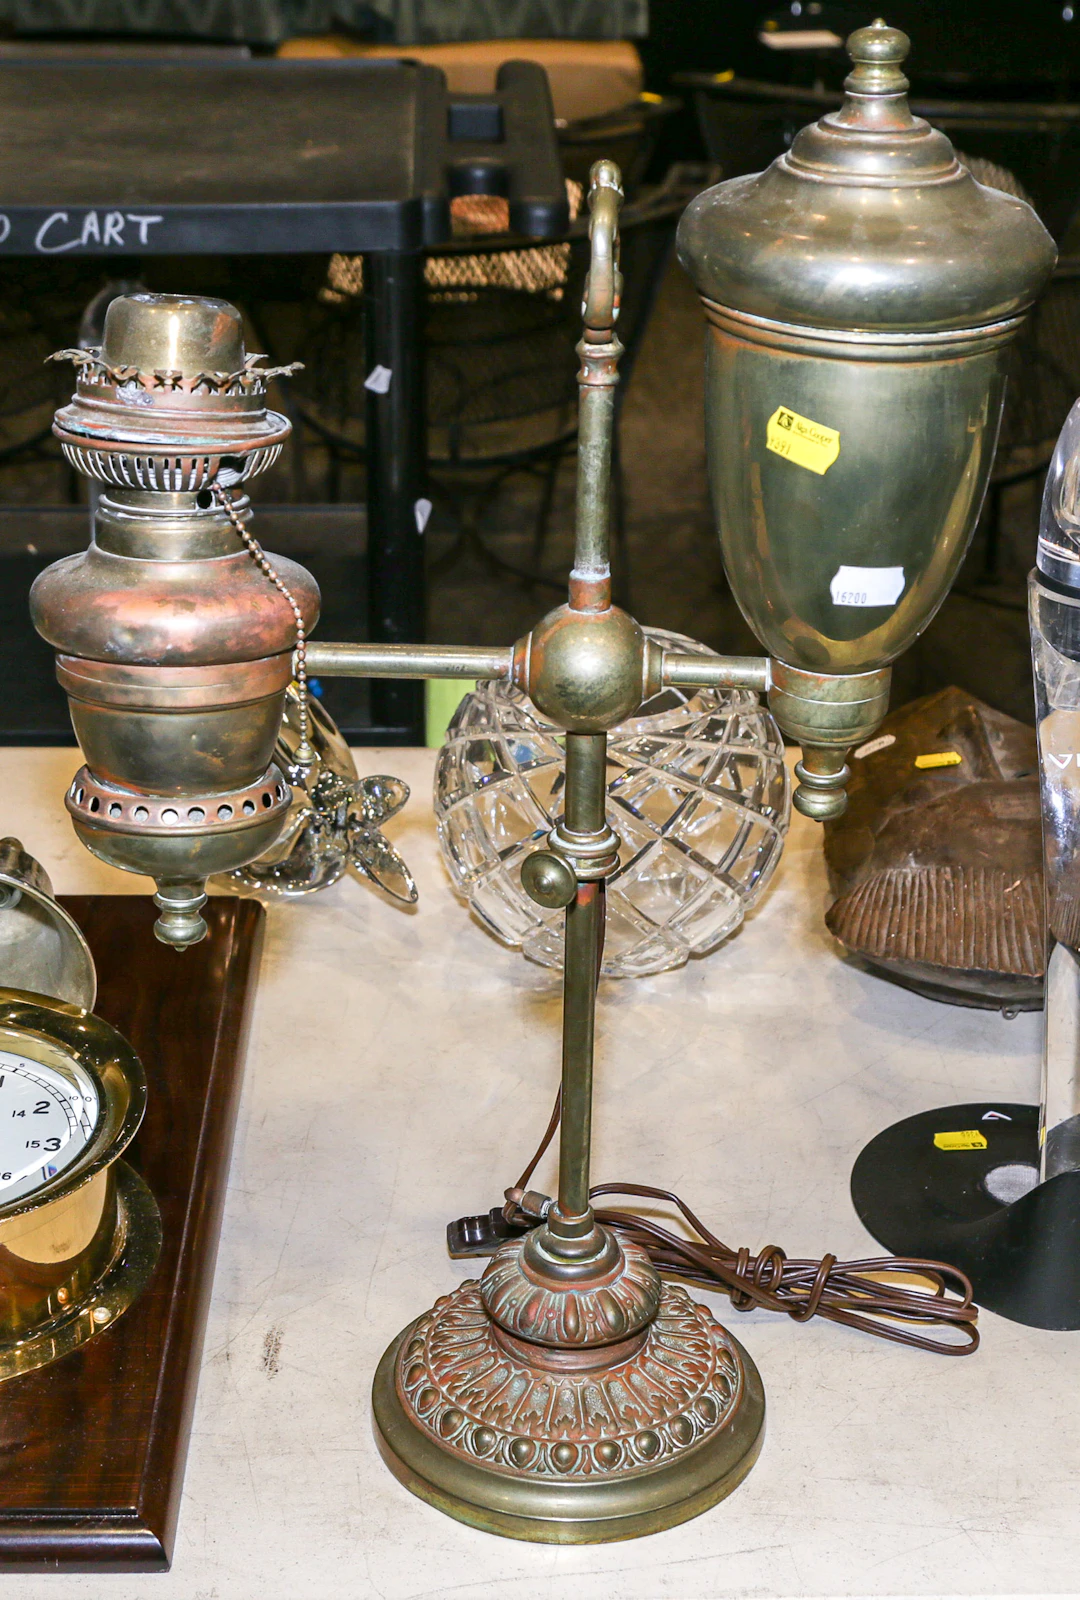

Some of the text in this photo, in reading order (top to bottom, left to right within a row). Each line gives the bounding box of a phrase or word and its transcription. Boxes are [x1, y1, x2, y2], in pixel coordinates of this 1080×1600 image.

[35, 211, 163, 253] CART
[835, 591, 867, 604] 16200
[11, 1101, 51, 1118] 14 2
[25, 1137, 61, 1152] 15 3
